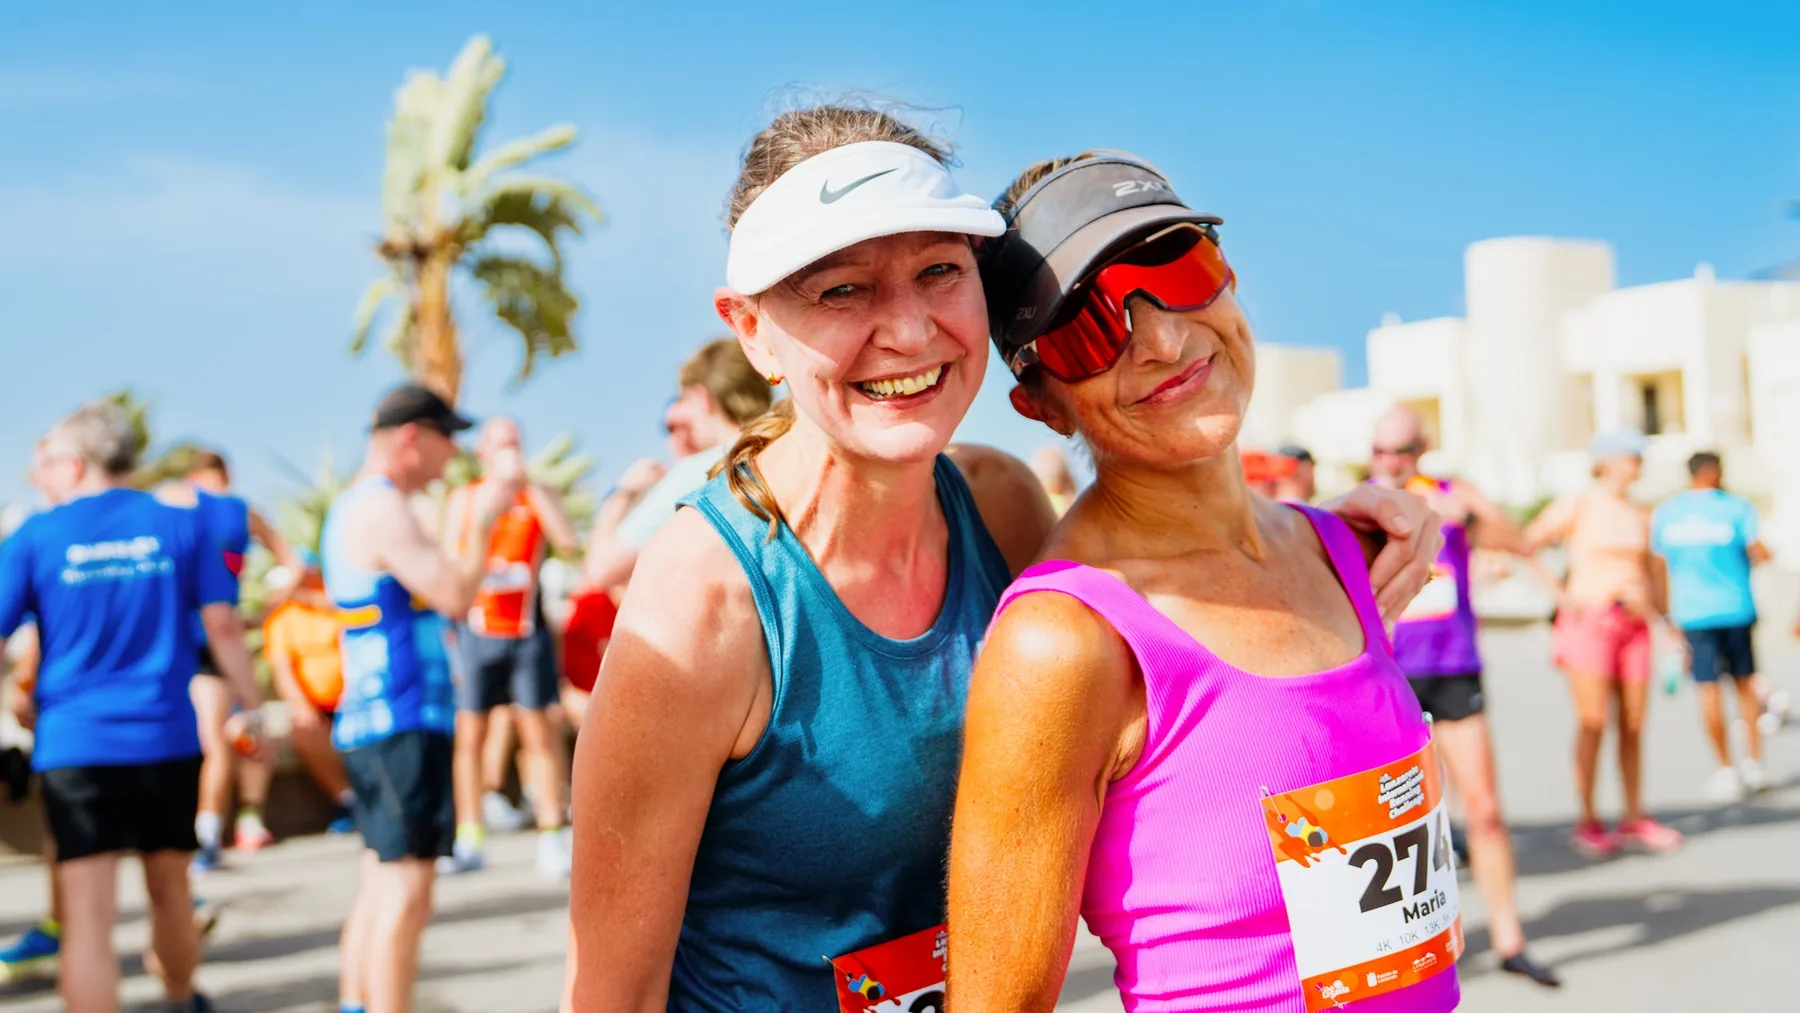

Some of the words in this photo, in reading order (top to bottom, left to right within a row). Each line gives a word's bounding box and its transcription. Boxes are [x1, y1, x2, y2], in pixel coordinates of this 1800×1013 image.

[1402, 889, 1447, 924] Maria
[1376, 939, 1393, 953] 4K
[1399, 929, 1420, 945] 10K
